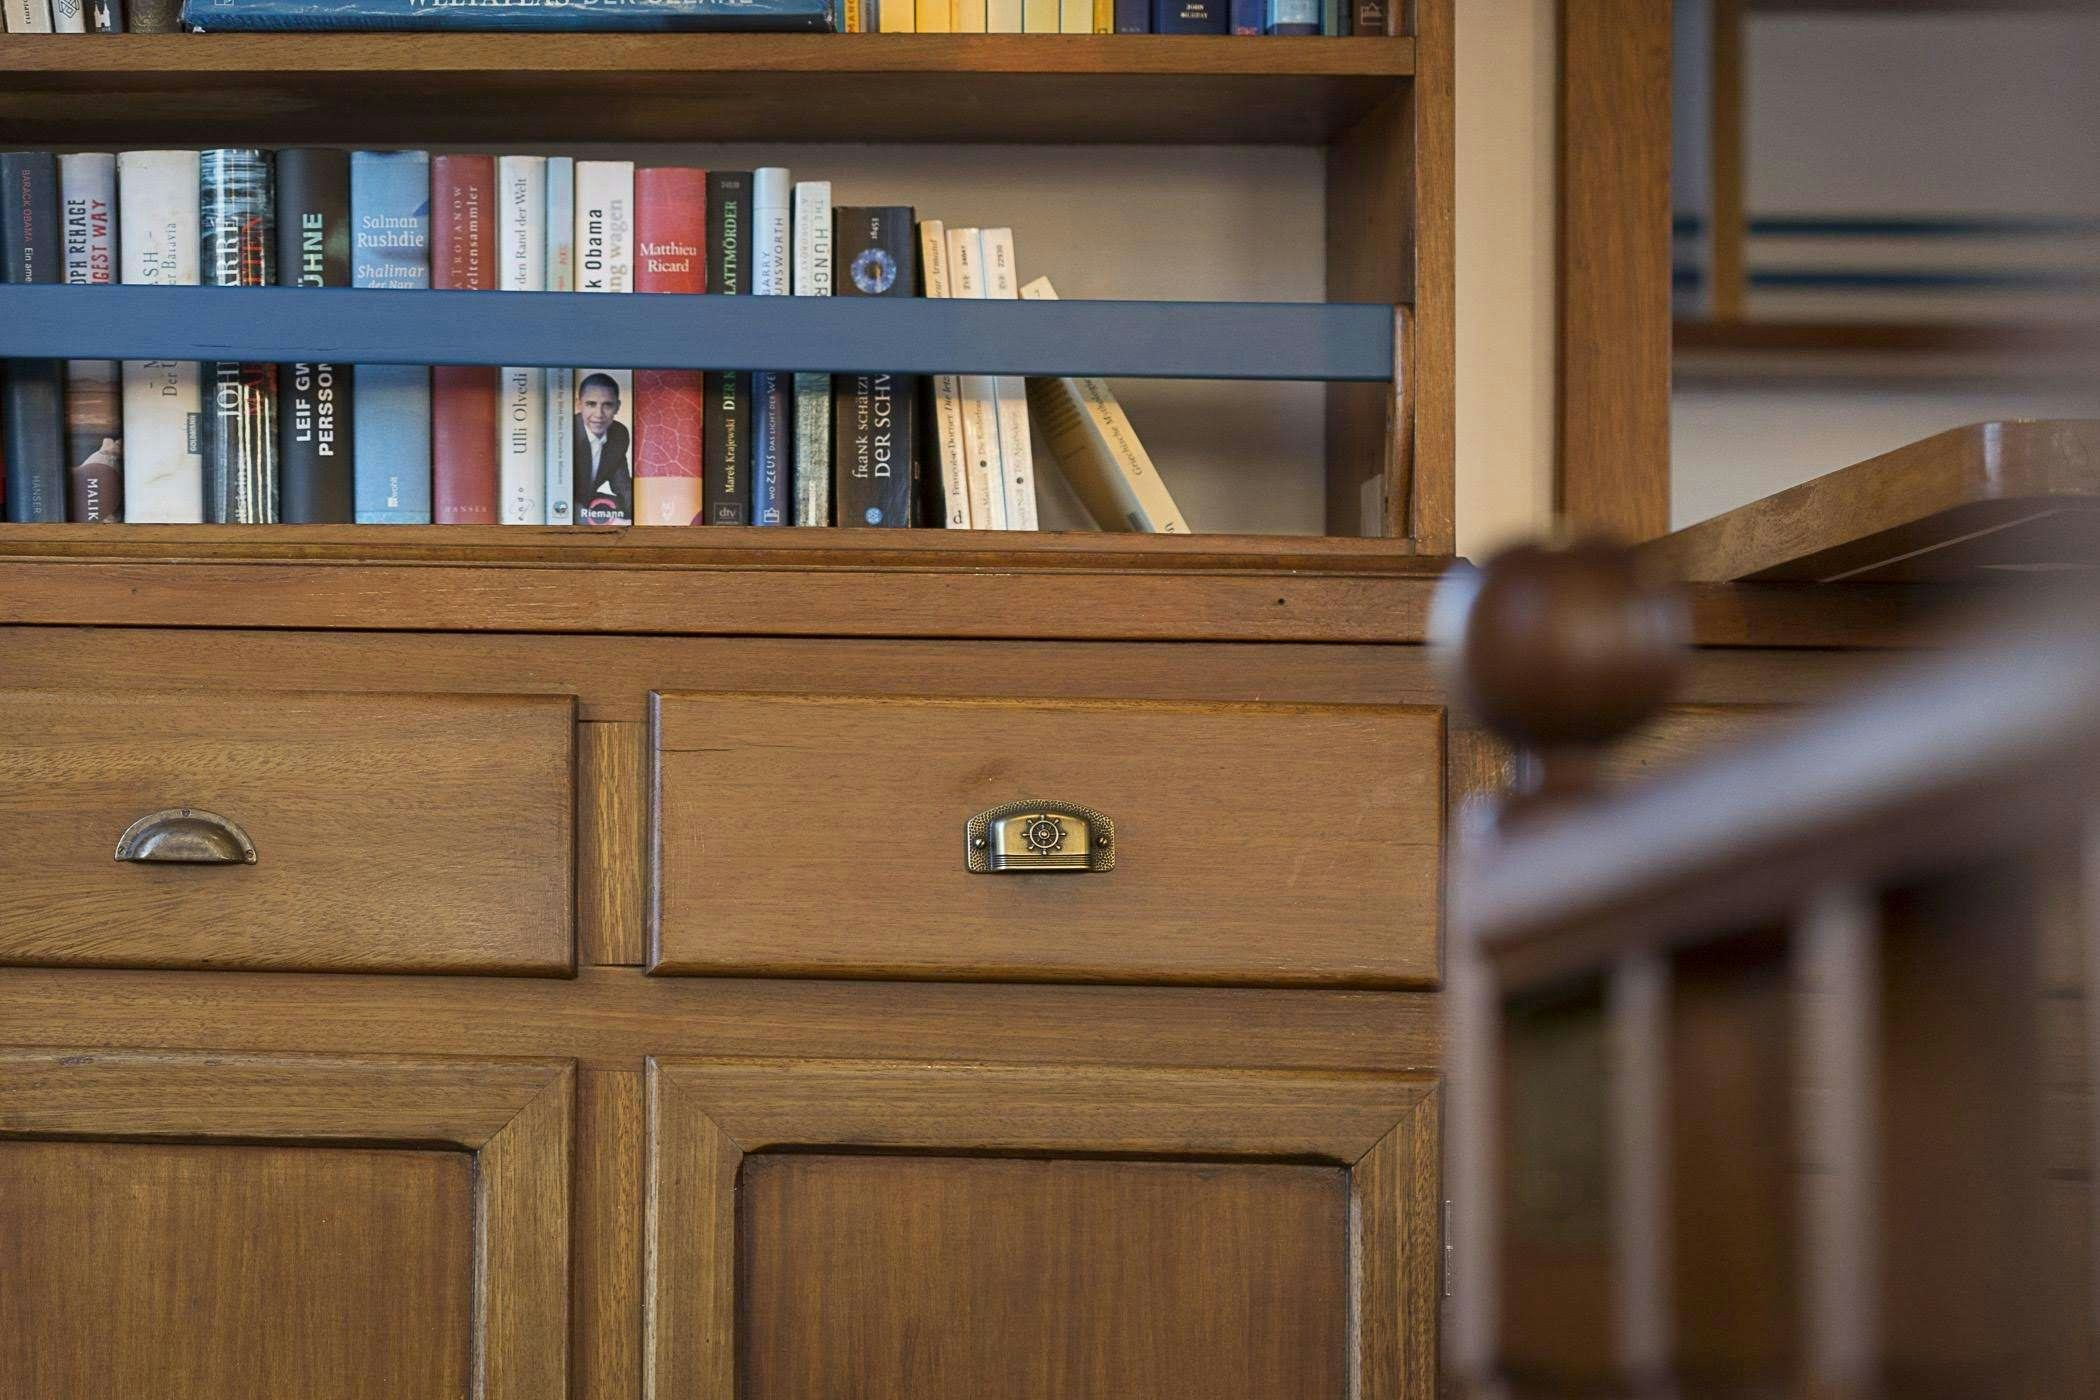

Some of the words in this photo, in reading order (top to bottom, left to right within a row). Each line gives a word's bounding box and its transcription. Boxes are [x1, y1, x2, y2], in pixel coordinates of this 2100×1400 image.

[514, 178, 527, 206] Welt
[23, 208, 32, 242] OBAMA
[67, 200, 86, 254] REHAGE
[90, 200, 107, 237] WAY
[362, 214, 418, 229] Salman
[609, 200, 628, 258] wagen
[357, 230, 424, 247] Rushdie
[467, 186, 479, 290] eltensammler
[514, 230, 527, 259] Rand
[584, 209, 602, 270] Obama
[640, 242, 697, 256] Matthieu
[24, 247, 33, 261] Ein
[90, 245, 109, 285] GEST
[648, 259, 689, 272] Ricard
[357, 263, 425, 278] Shalimar
[162, 373, 179, 397] Der
[512, 372, 528, 422] Olvedi
[296, 398, 312, 442] LEIF
[512, 428, 528, 454] Ulli
[724, 418, 738, 463] Krajewski
[724, 466, 735, 493] Marek
[766, 455, 776, 483] ZEUS
[87, 478, 99, 520] MALIK
[580, 508, 625, 518] Riemann
